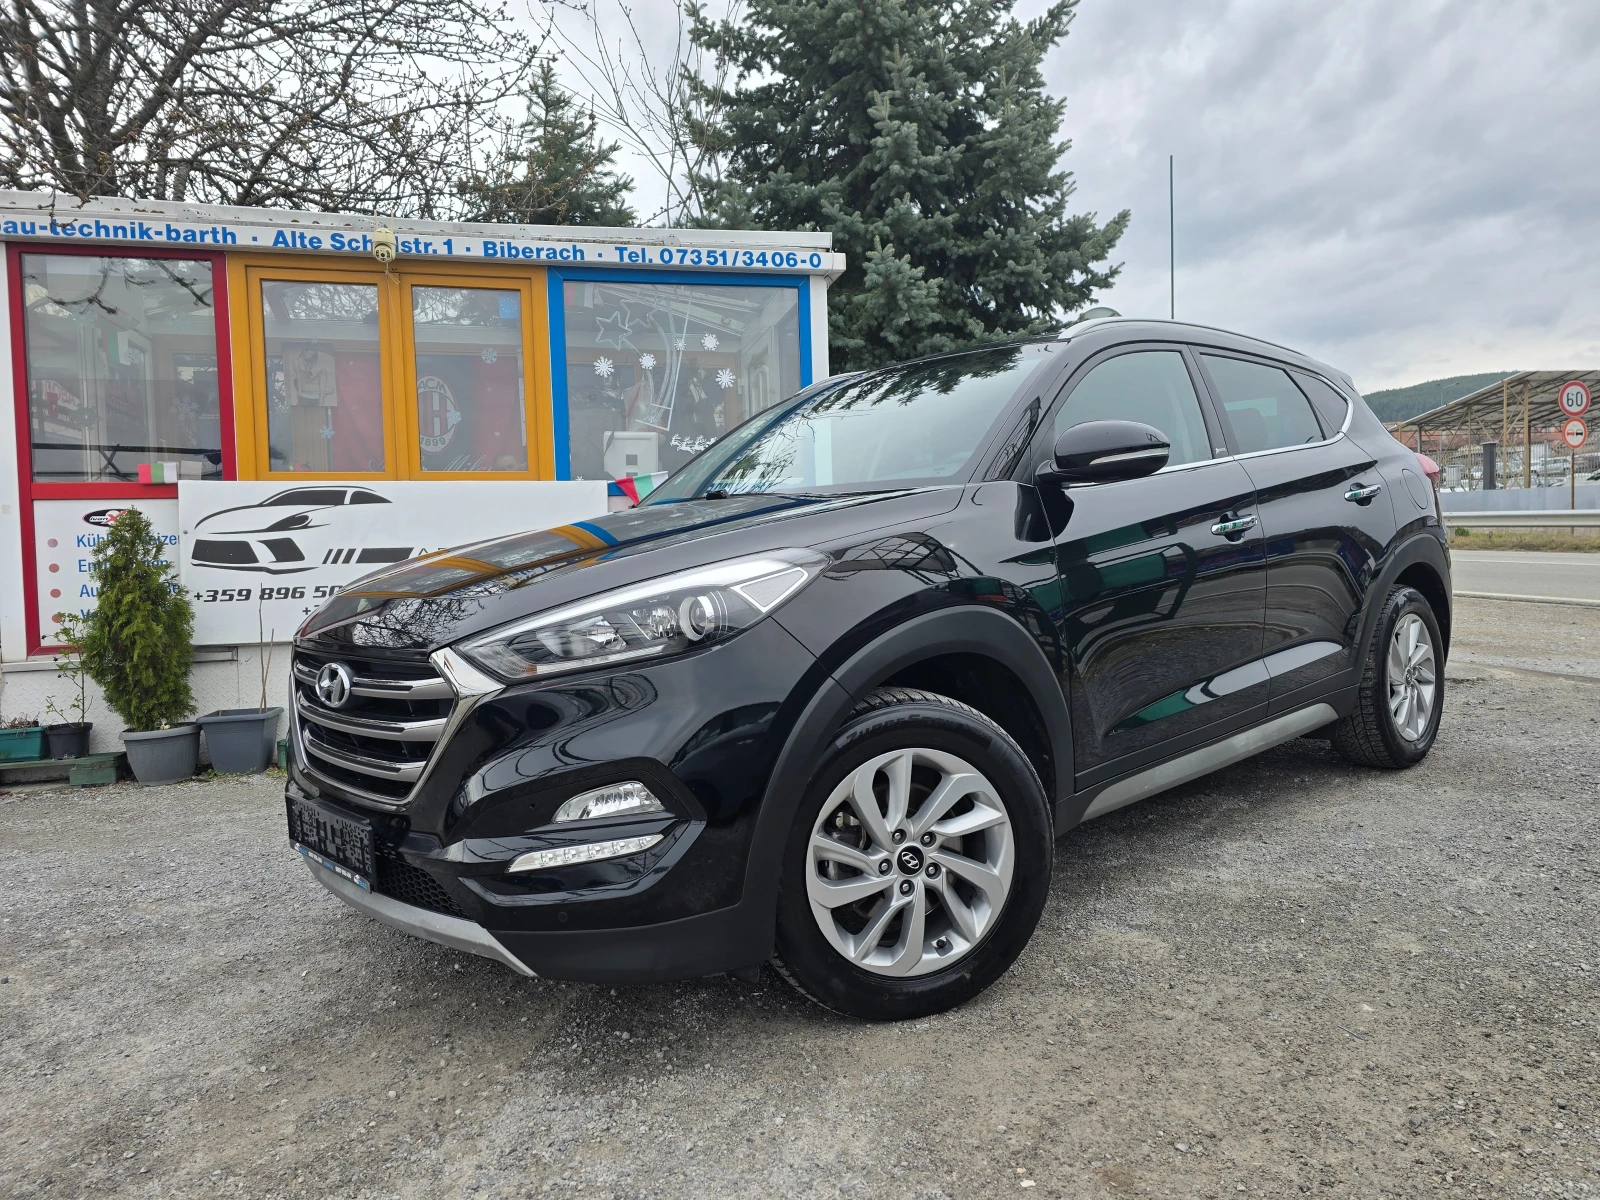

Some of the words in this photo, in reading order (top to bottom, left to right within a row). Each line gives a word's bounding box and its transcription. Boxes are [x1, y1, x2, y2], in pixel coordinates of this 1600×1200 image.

[0, 218, 237, 245] au-technik-barth
[272, 229, 323, 250] Alte
[330, 232, 438, 255] Schlstr.
[483, 240, 586, 261] Biberach
[615, 246, 653, 264] Tel.
[659, 247, 822, 269] 07351/3406-0
[417, 378, 448, 395] ACM
[1566, 392, 1583, 407] 60
[420, 437, 446, 447] 1899
[194, 588, 252, 603] +359
[259, 586, 307, 600] 896
